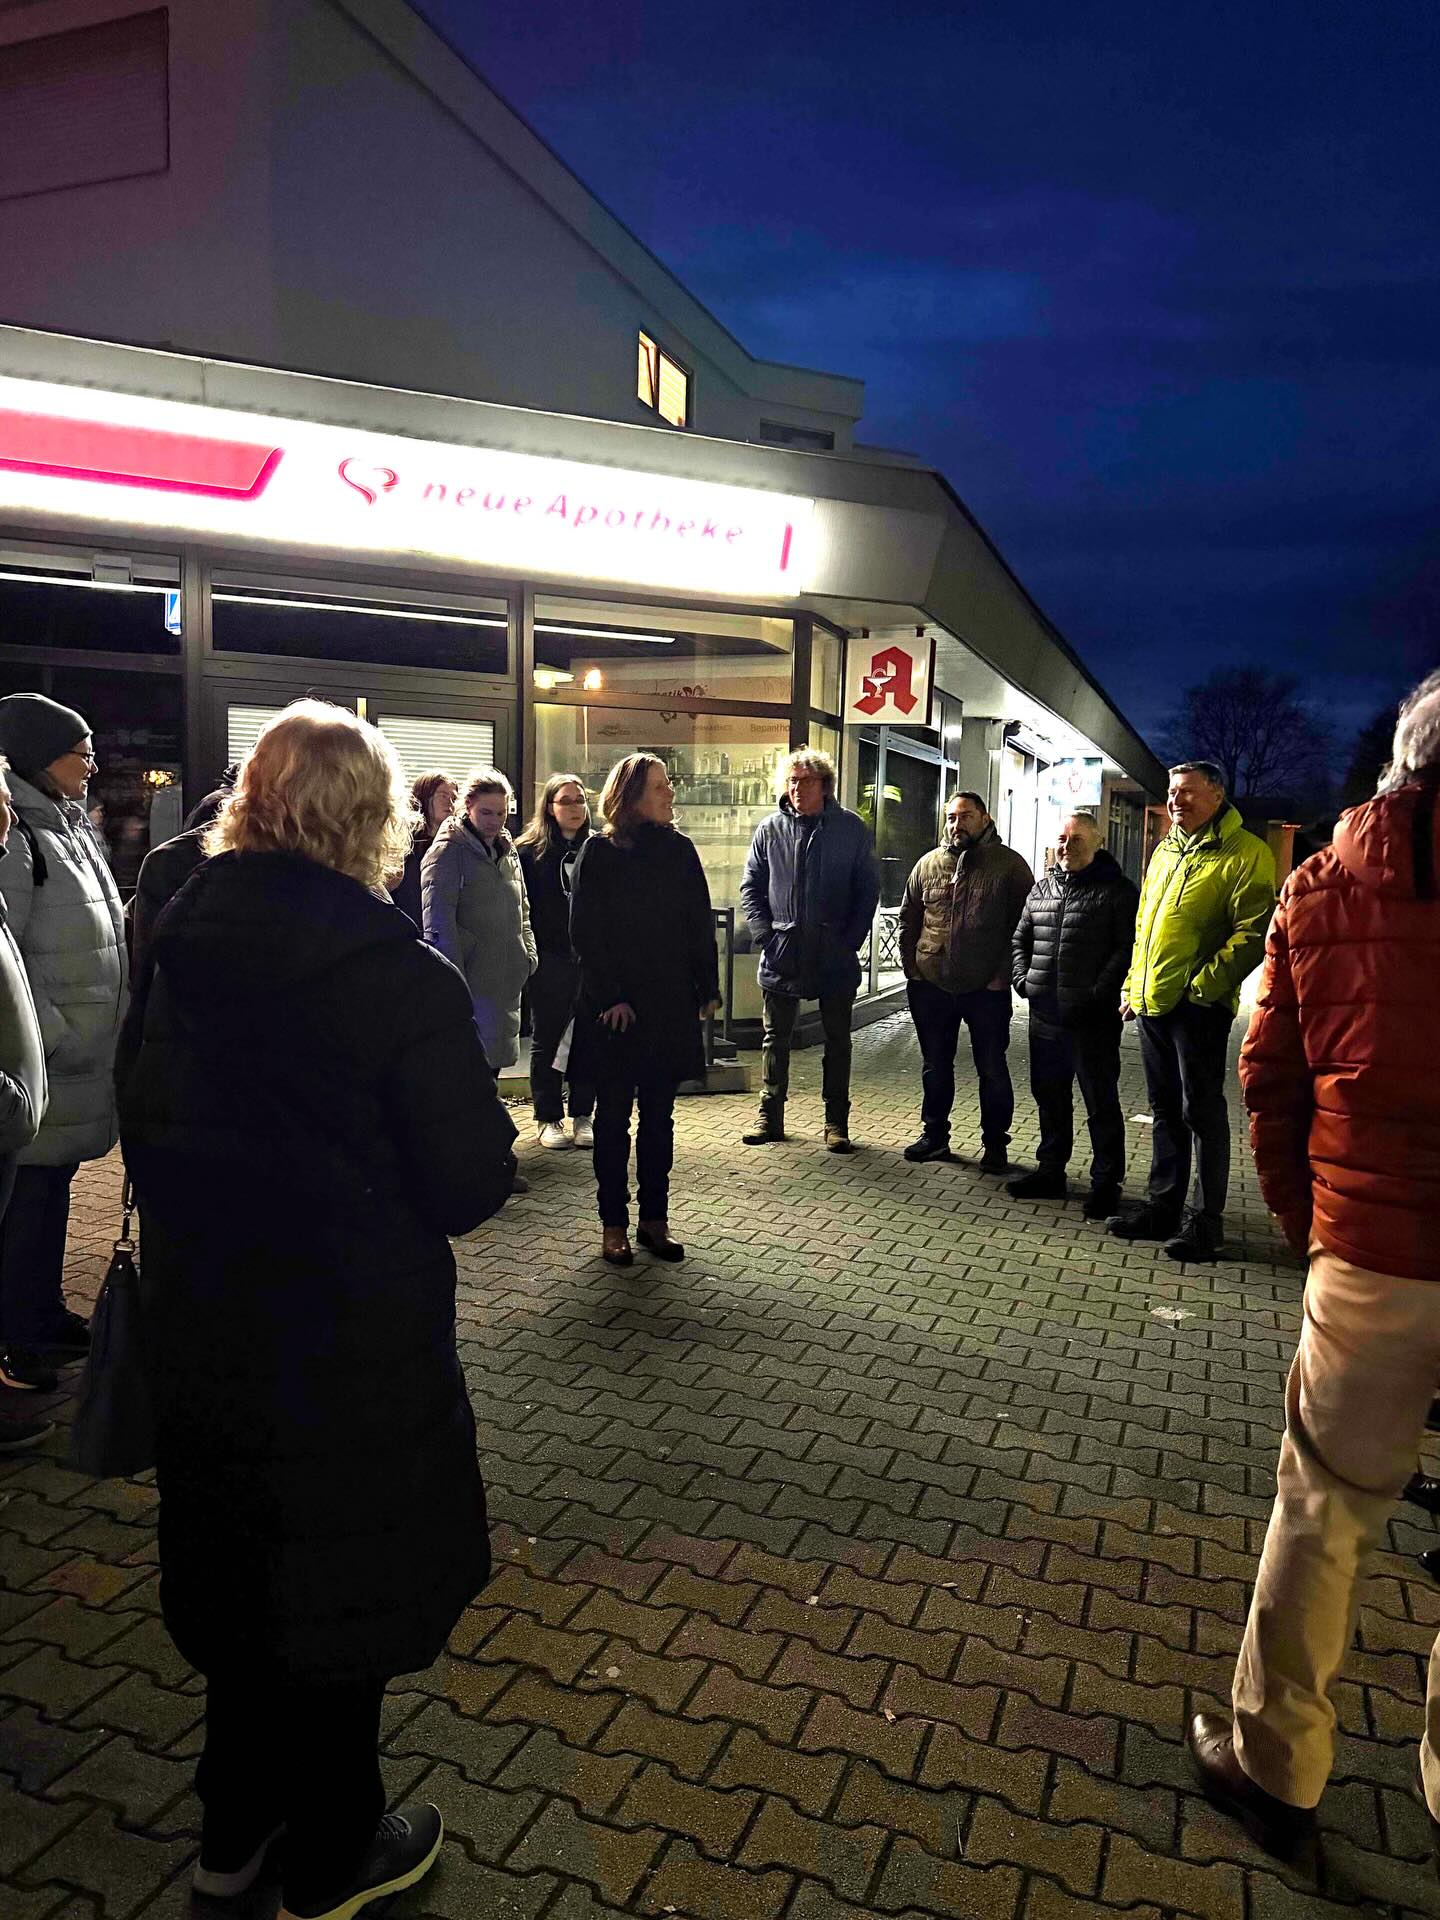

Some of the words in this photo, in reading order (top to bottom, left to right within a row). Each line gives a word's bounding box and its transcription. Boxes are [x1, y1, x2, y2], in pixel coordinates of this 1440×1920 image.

[422, 482, 533, 515] neue
[545, 494, 745, 544] Apotheke
[852, 646, 918, 716] A
